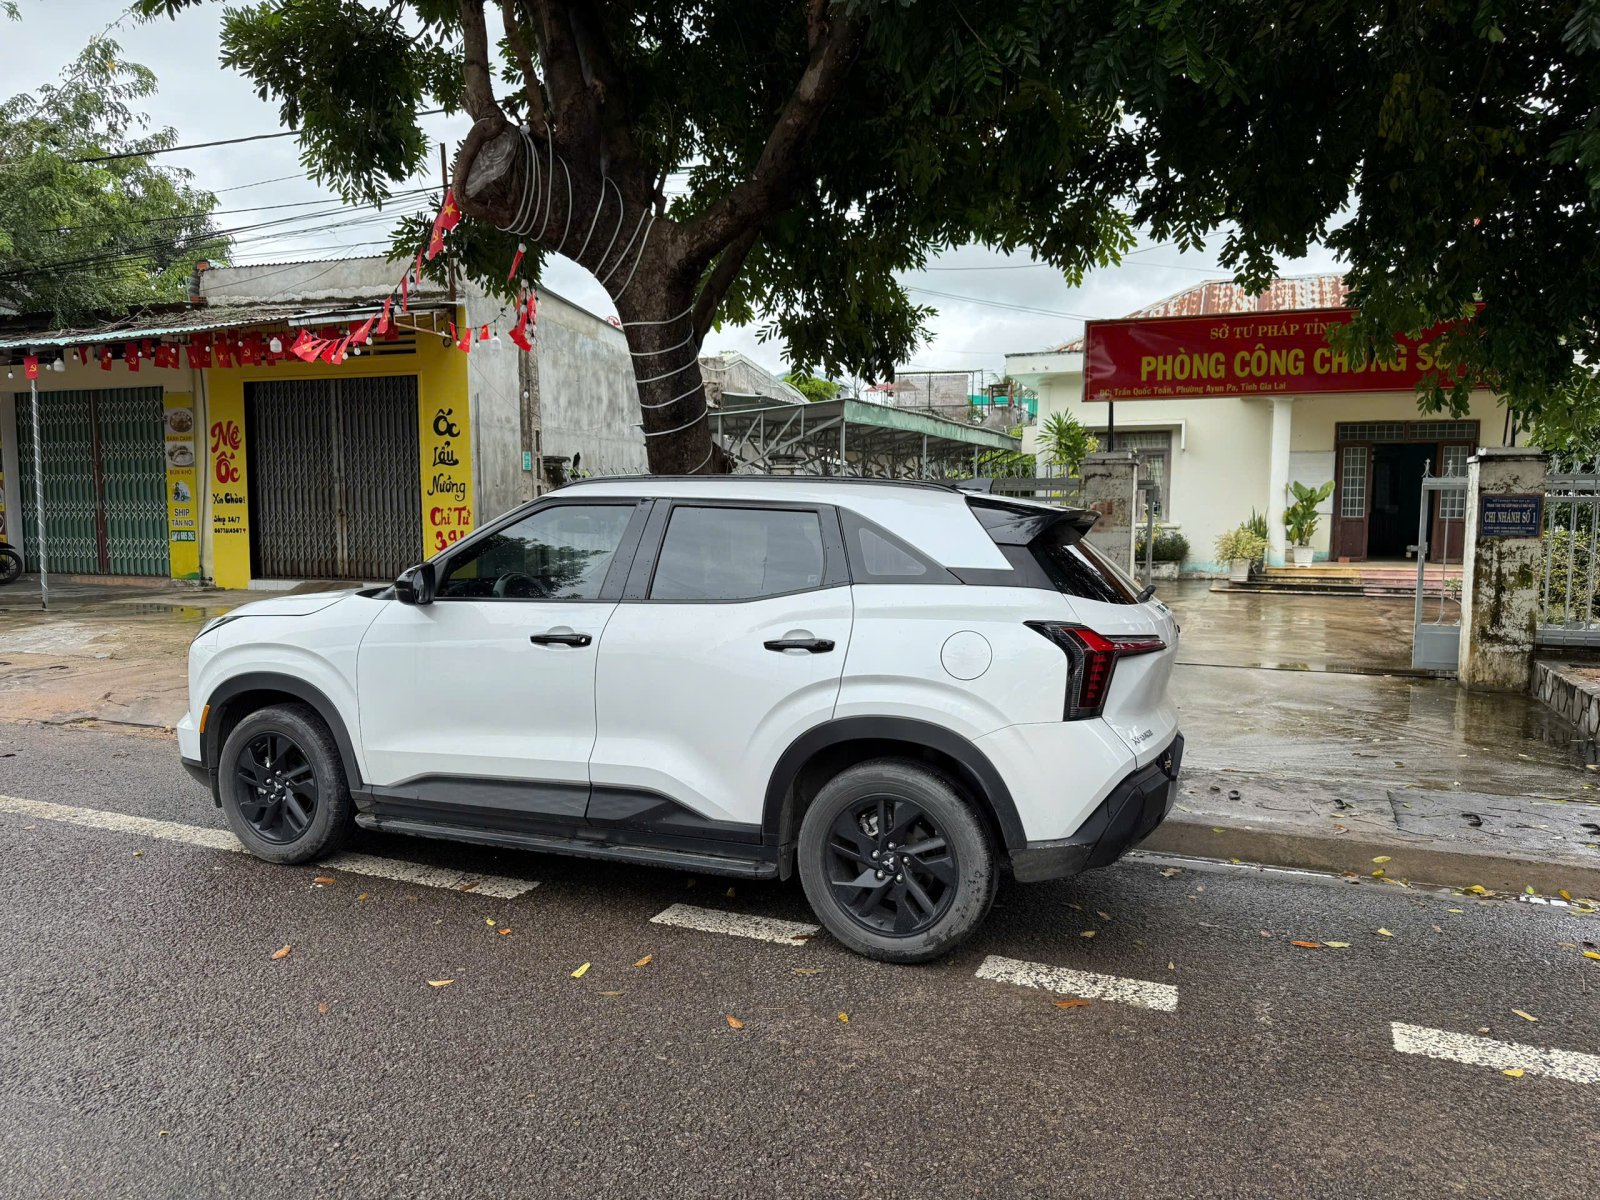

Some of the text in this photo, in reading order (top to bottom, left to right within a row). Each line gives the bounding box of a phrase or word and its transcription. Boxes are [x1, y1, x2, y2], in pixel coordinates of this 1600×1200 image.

[1210, 318, 1341, 339] SỞ TƯ PHÁP TỈN
[1141, 347, 1225, 381] PHÒNG
[1234, 343, 1305, 377] CÔNG
[1133, 386, 1151, 396] Quốc
[1206, 384, 1224, 393] Ayun
[1226, 383, 1239, 392] Pa,
[1260, 382, 1272, 390] Gia
[1274, 381, 1286, 390] Lai
[433, 408, 461, 438] Ốc
[211, 420, 241, 453] Mê
[432, 440, 459, 467] Lẩu
[216, 451, 241, 484] Ốc
[213, 493, 224, 504] Xin
[427, 473, 466, 502] Nướng
[174, 508, 190, 516] SHIP
[430, 506, 452, 526] Chỉ
[1485, 511, 1496, 523] CHI
[1497, 509, 1521, 523] NHÁNH
